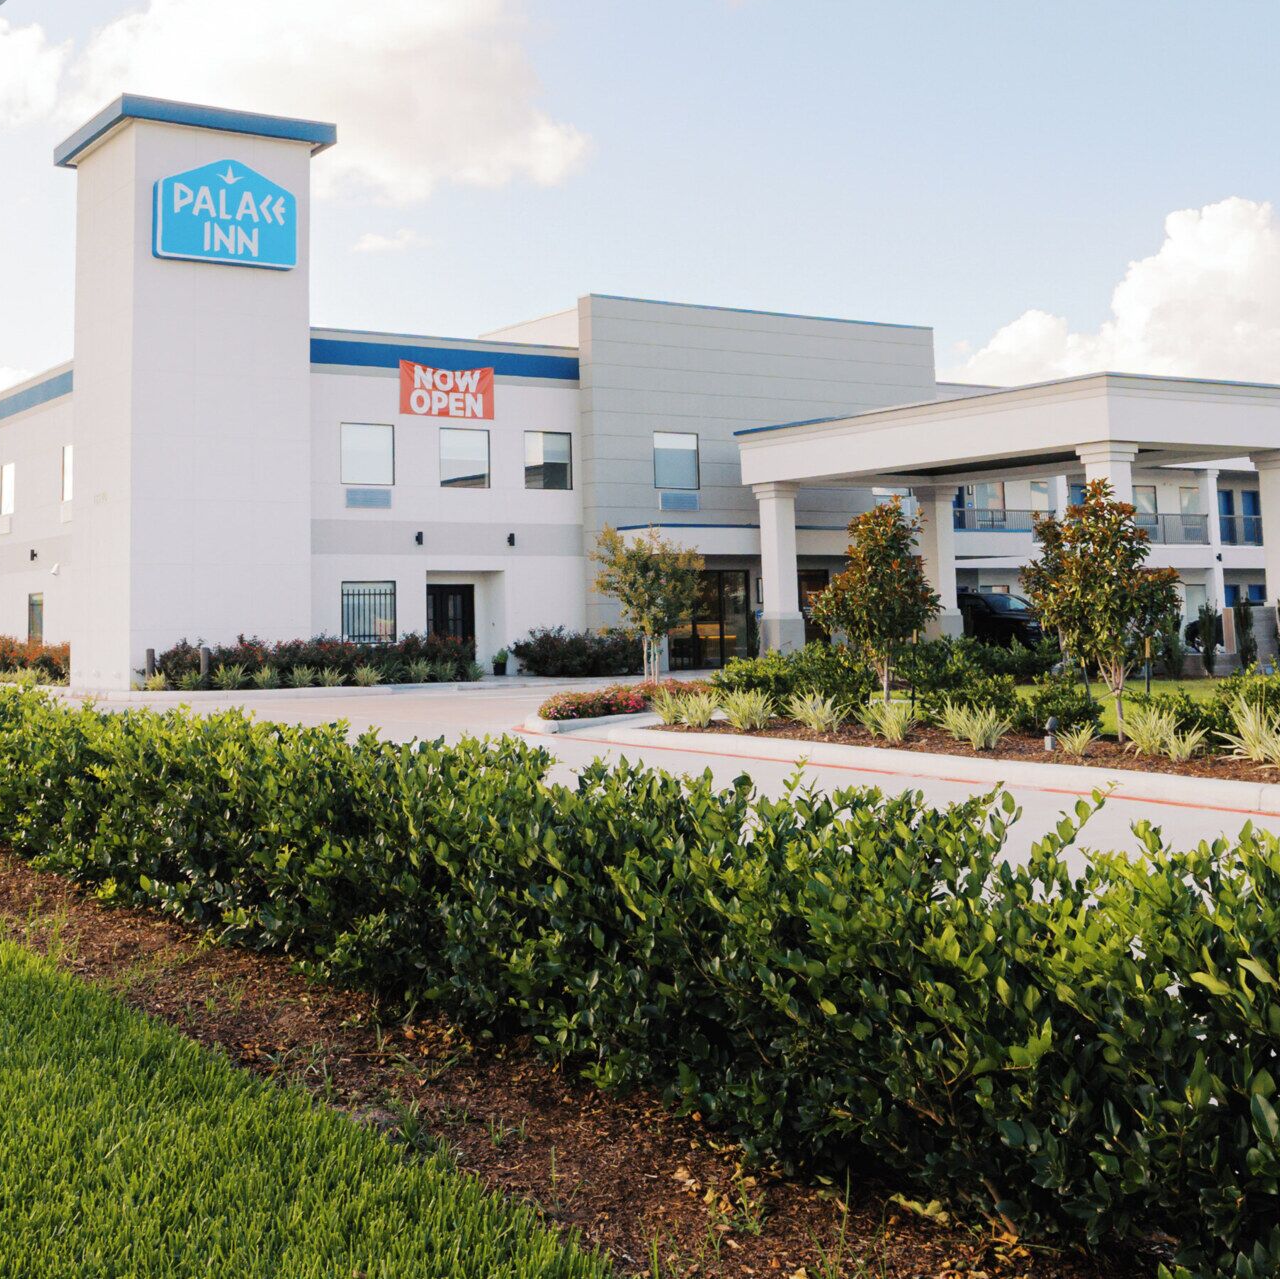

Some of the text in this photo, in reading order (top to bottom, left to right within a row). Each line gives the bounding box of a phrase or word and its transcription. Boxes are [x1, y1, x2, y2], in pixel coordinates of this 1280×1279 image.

[173, 182, 286, 226] PALACE
[203, 220, 259, 258] INN
[414, 365, 482, 393] NOW
[410, 389, 484, 418] OPEN
